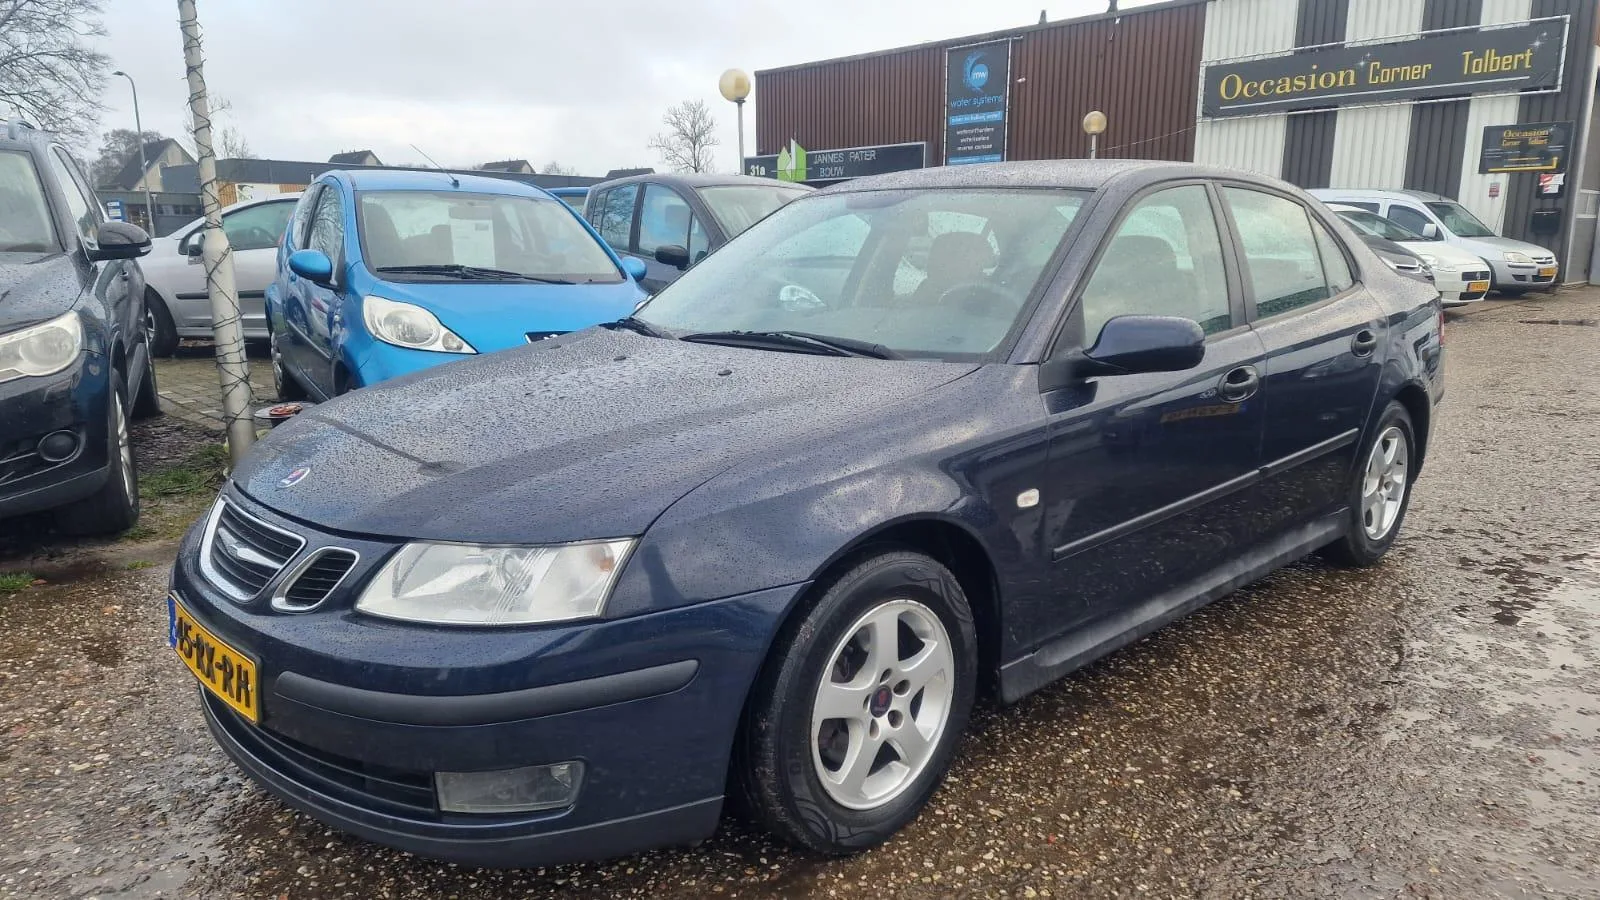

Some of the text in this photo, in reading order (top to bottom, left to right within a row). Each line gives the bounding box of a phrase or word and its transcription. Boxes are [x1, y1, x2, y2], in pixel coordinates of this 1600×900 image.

[1220, 48, 1533, 101] Occasion Corner Tolbert
[951, 98, 971, 108] water
[813, 150, 877, 165] JANNES PATER
[750, 165, 766, 176] 31a
[819, 166, 844, 177] BOUW
